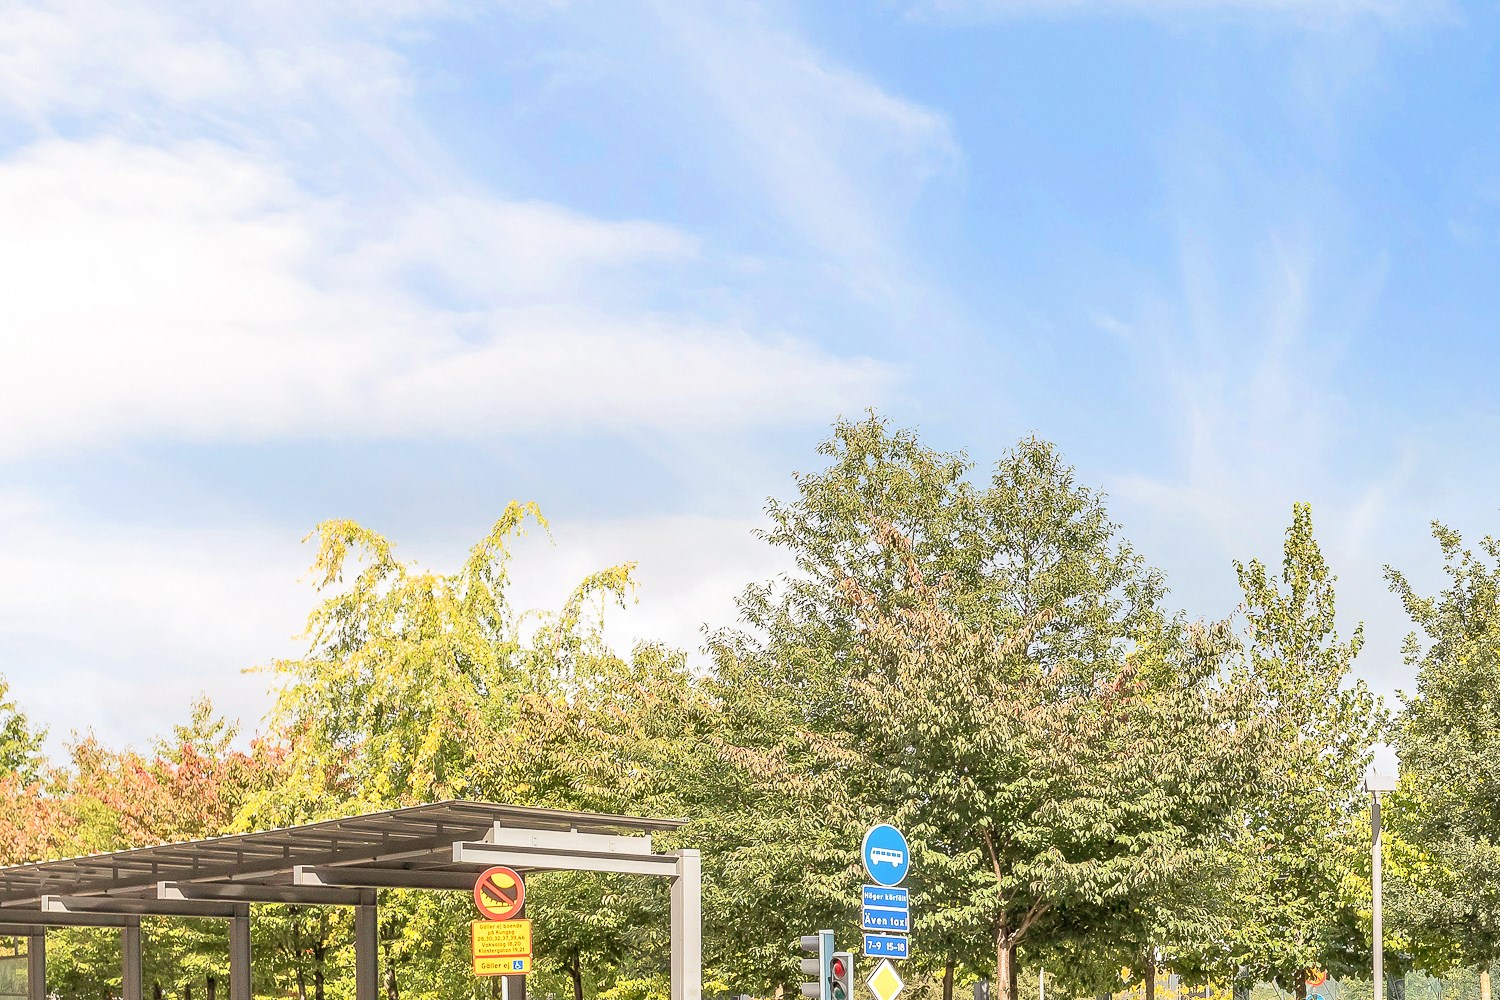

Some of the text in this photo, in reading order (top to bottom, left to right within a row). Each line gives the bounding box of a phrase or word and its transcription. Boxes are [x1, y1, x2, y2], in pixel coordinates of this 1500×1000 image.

[864, 892, 883, 900] Höger
[864, 912, 908, 927] Även taxi
[503, 961, 510, 969] ej
